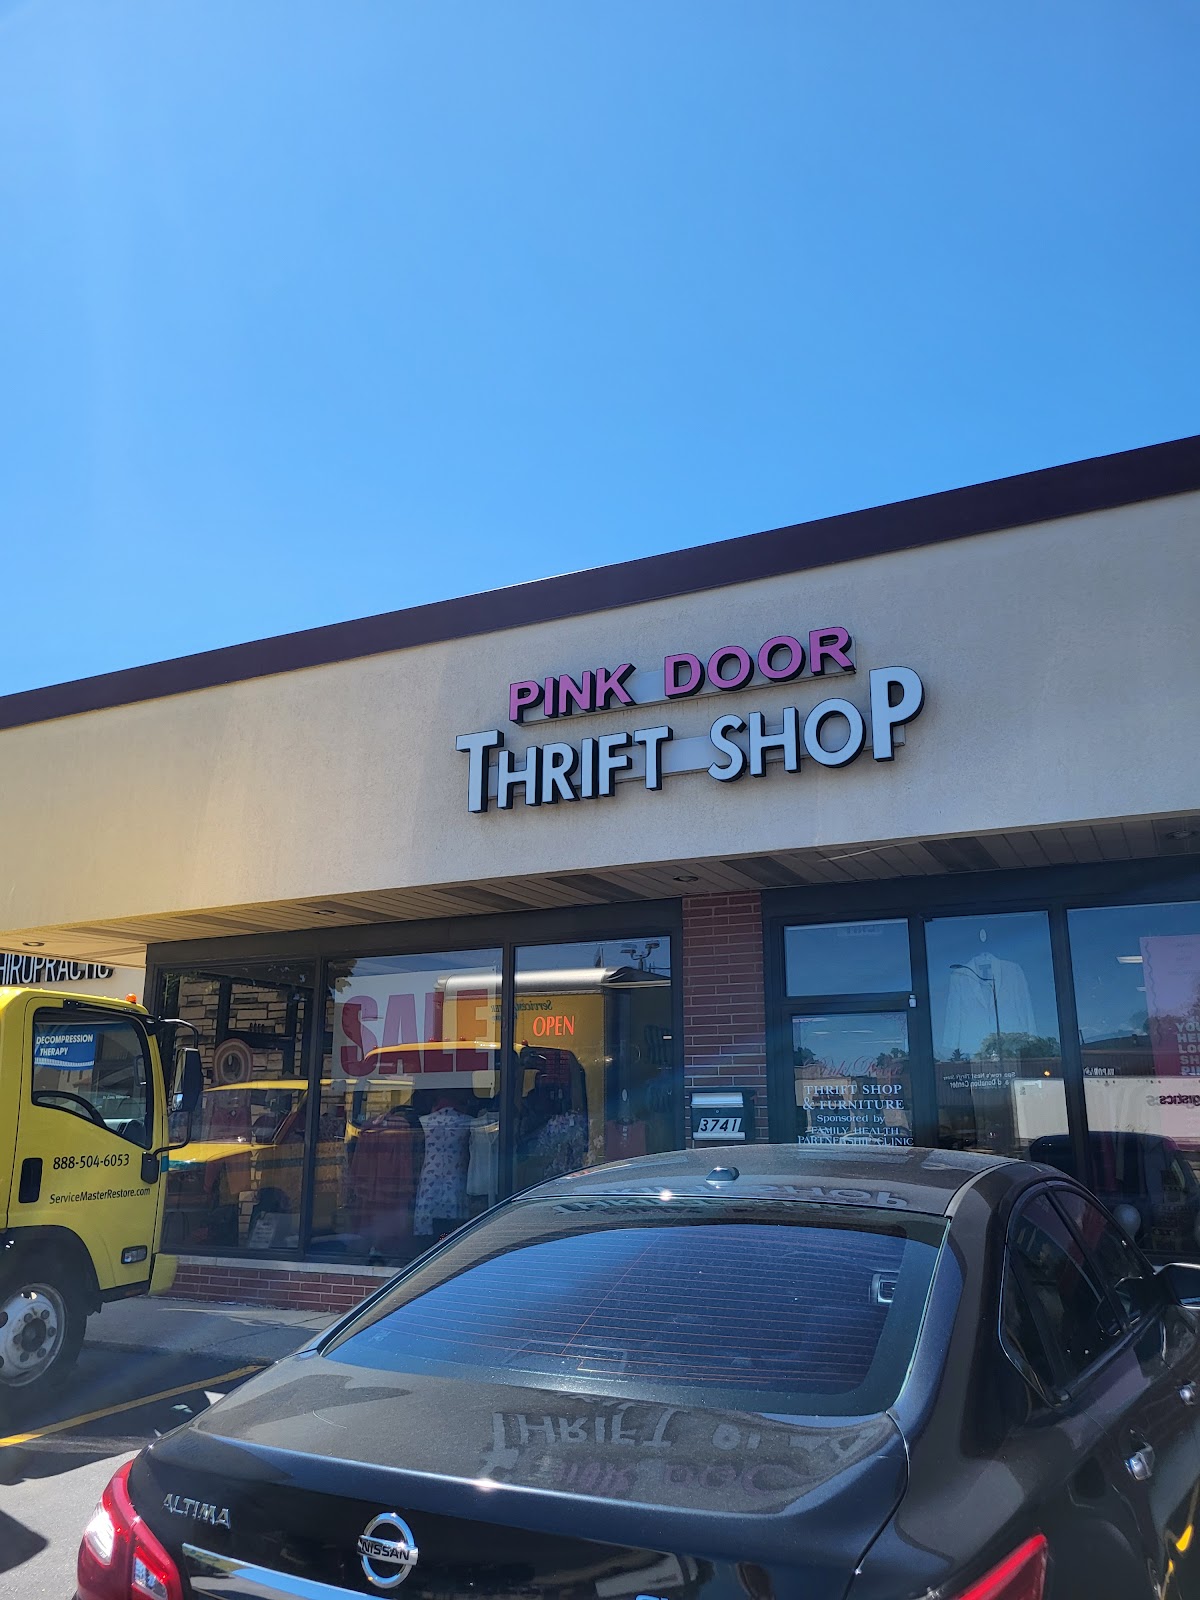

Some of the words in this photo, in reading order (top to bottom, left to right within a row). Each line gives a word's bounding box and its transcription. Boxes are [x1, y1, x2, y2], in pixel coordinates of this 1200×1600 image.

[509, 663, 636, 723] PINK
[664, 627, 855, 698] DOOR
[455, 725, 672, 812] THRIFT
[707, 666, 924, 783] SHOP
[339, 989, 489, 1077] SALE
[532, 1015, 575, 1037] OPEN
[36, 1033, 94, 1045] DECOMPRESSION
[39, 1047, 69, 1057] THERAPY
[804, 1084, 858, 1095] THRIFT
[863, 1084, 902, 1095] SHOP
[803, 1096, 814, 1110] &
[820, 1099, 905, 1110] FURNITURE
[699, 1119, 739, 1132] 3741
[817, 1114, 868, 1123] Sponsored
[873, 1114, 886, 1124] by
[811, 1126, 850, 1135] FAMILY
[854, 1127, 899, 1135] HEALTH
[876, 1137, 915, 1146] CLINIC
[53, 1153, 130, 1170] 888-504-6053
[50, 1186, 151, 1205] ServiceMasterRestore.com
[161, 1493, 232, 1529] ALTIMA
[361, 1541, 410, 1561] NISSAN
